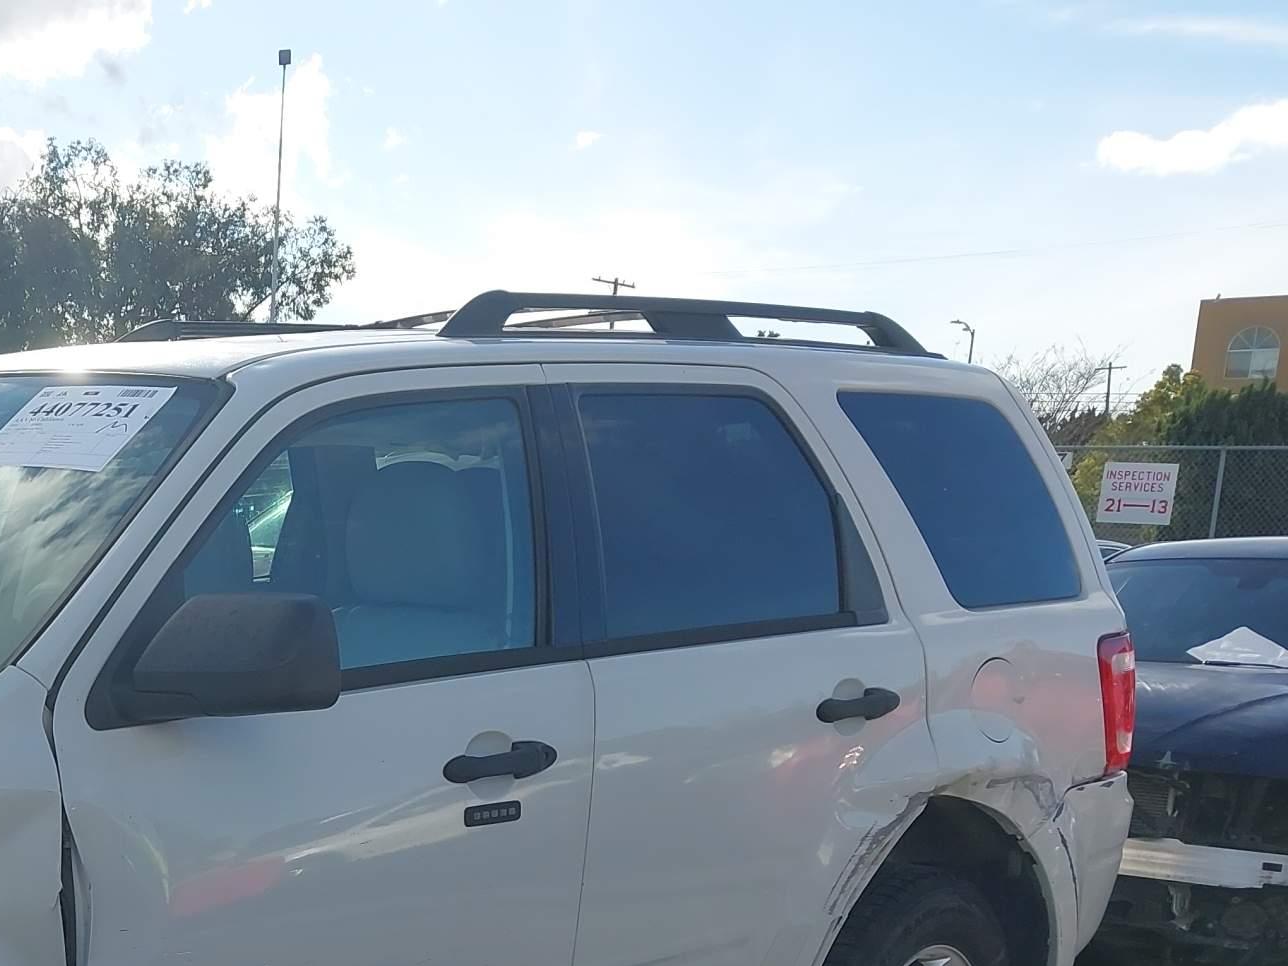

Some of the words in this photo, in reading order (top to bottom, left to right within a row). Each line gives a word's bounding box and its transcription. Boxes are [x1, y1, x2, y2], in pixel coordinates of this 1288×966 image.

[29, 402, 140, 418] 44077251
[1106, 470, 1172, 482] INSPECTION
[1111, 481, 1164, 493] SERVICES
